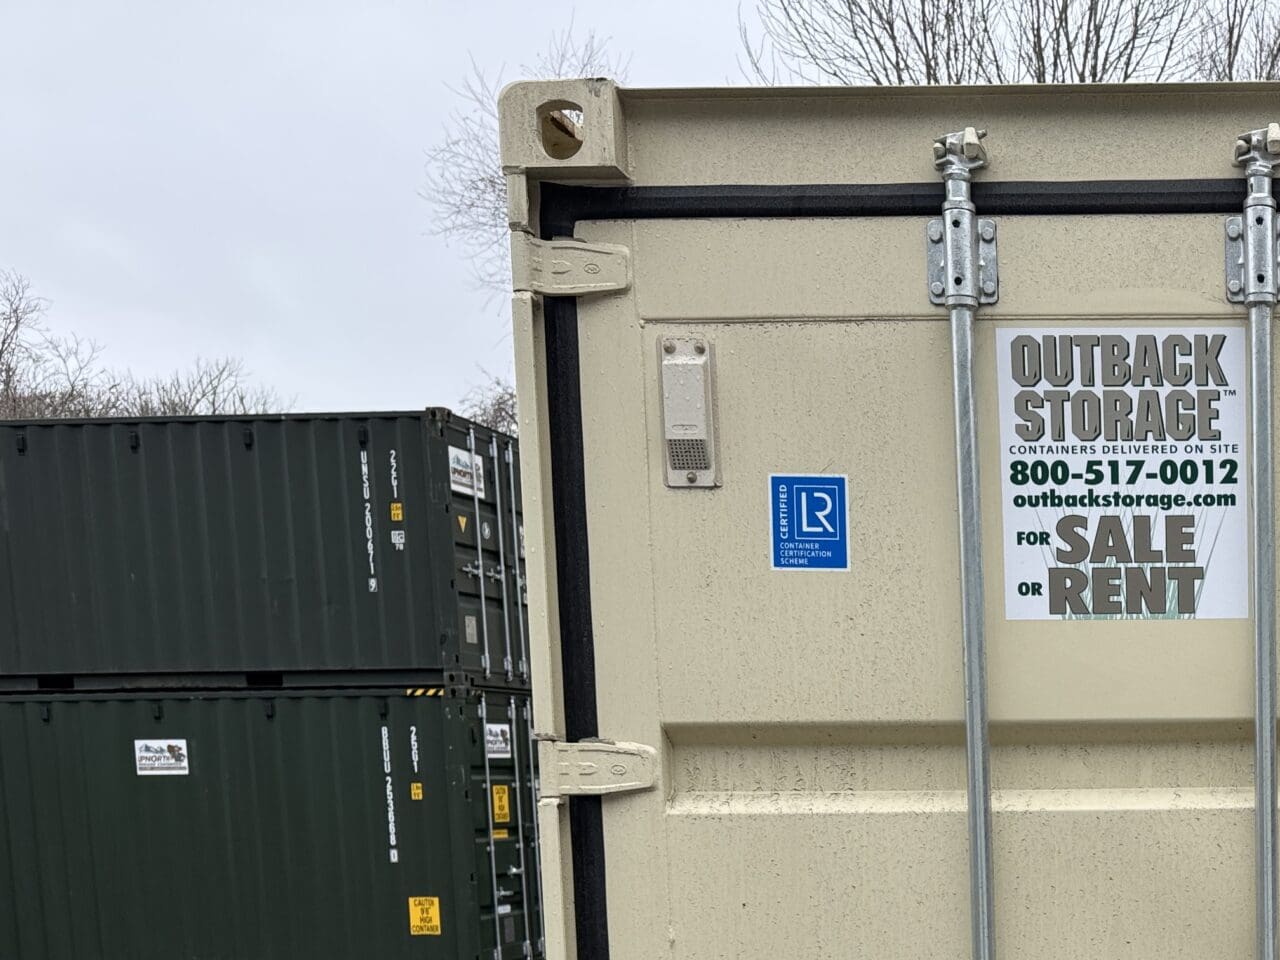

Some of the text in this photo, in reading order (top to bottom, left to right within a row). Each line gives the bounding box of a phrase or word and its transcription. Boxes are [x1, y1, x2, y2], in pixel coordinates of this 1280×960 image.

[1010, 334, 1228, 387] OUTBACK
[1014, 389, 1222, 442] STORAGE
[1009, 443, 1239, 455] CONTAINERS DELIVERED ON SITE
[1009, 459, 1238, 485] 800-517-0012
[779, 484, 788, 539] CERTIFIED
[801, 492, 836, 533] LR
[1013, 489, 1237, 510] outbackstorage.com
[779, 542, 820, 550] CONTAINER
[779, 550, 832, 558] CERTIFICATION
[1016, 514, 1196, 564] FOR SALE
[1017, 566, 1204, 615] OR RENT
